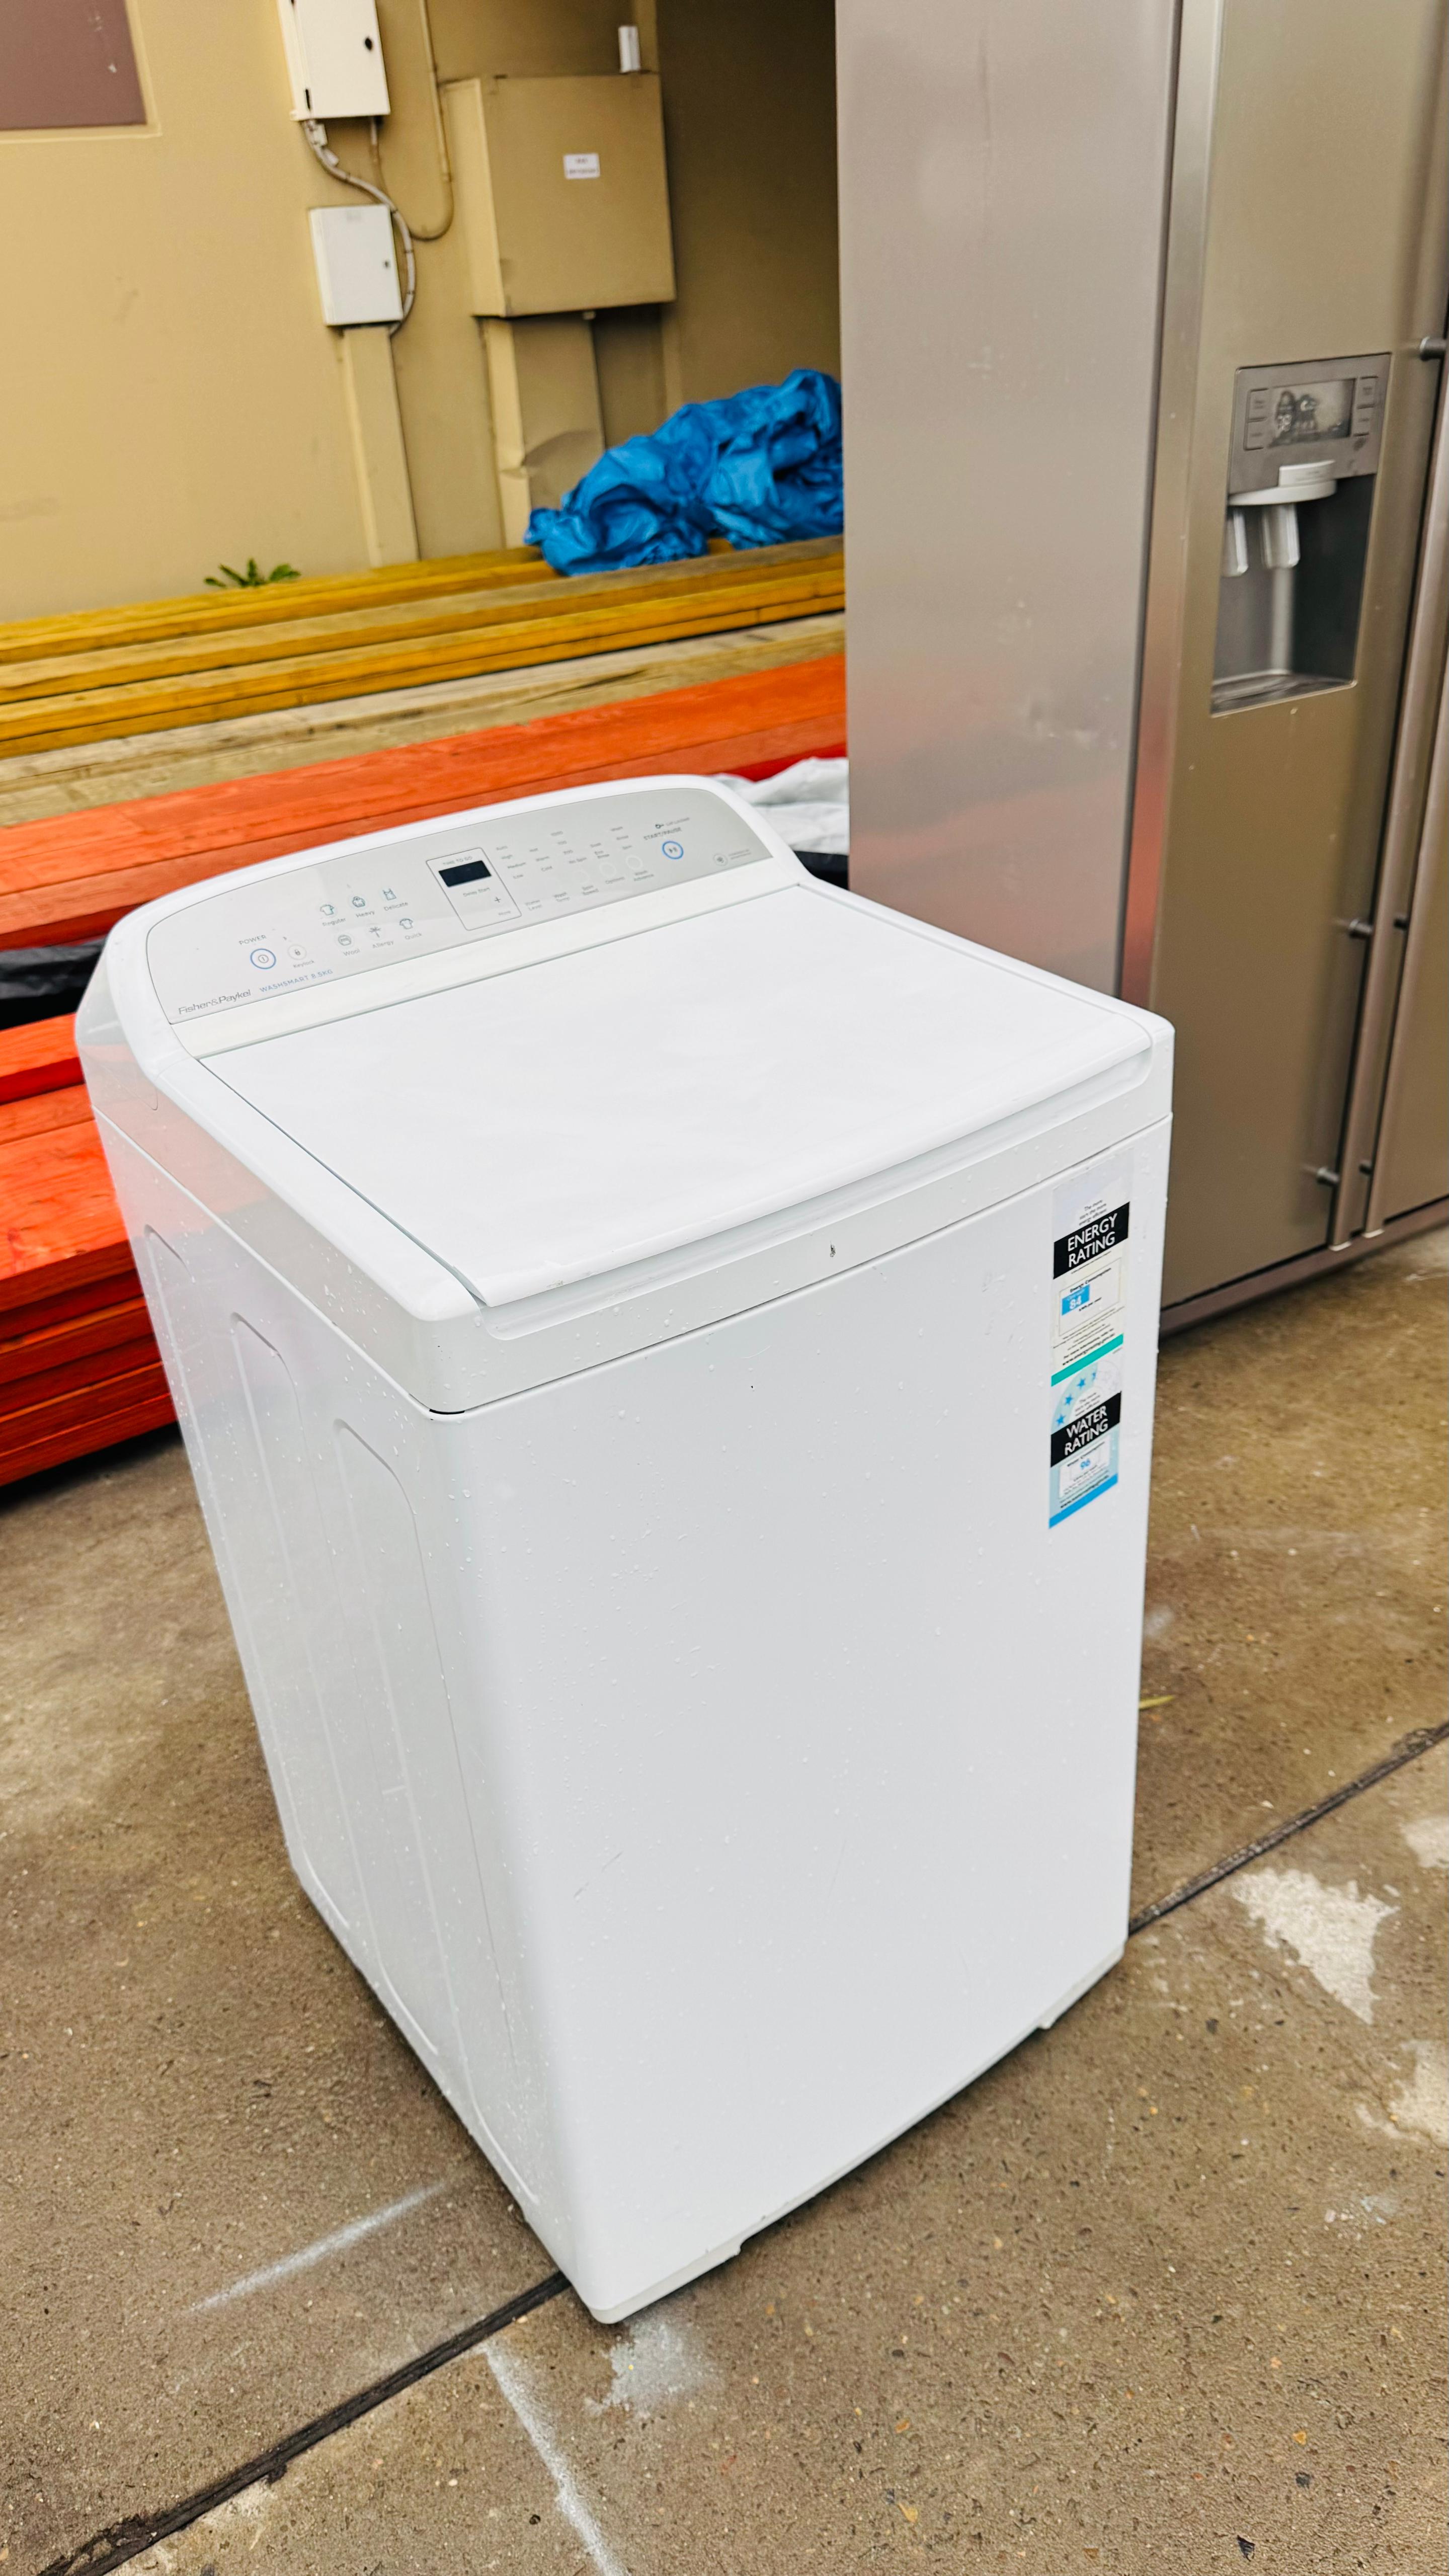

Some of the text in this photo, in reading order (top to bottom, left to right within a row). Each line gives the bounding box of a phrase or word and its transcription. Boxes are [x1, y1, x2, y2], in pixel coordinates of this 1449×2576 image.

[356, 910, 375, 918] Heavy
[383, 902, 409, 911] Delicate
[322, 917, 346, 927] Regular
[239, 934, 267, 945] POWER
[372, 940, 394, 949] Allergy
[259, 969, 334, 993] WASHSMART 8.5KG
[178, 989, 252, 1015] Fisher&Paykel
[1068, 1213, 1117, 1252] ENERGY
[1068, 1231, 1115, 1268] RATING
[1070, 1295, 1082, 1310] 84
[1067, 1406, 1107, 1438] WATER
[1065, 1418, 1108, 1456] RATING
